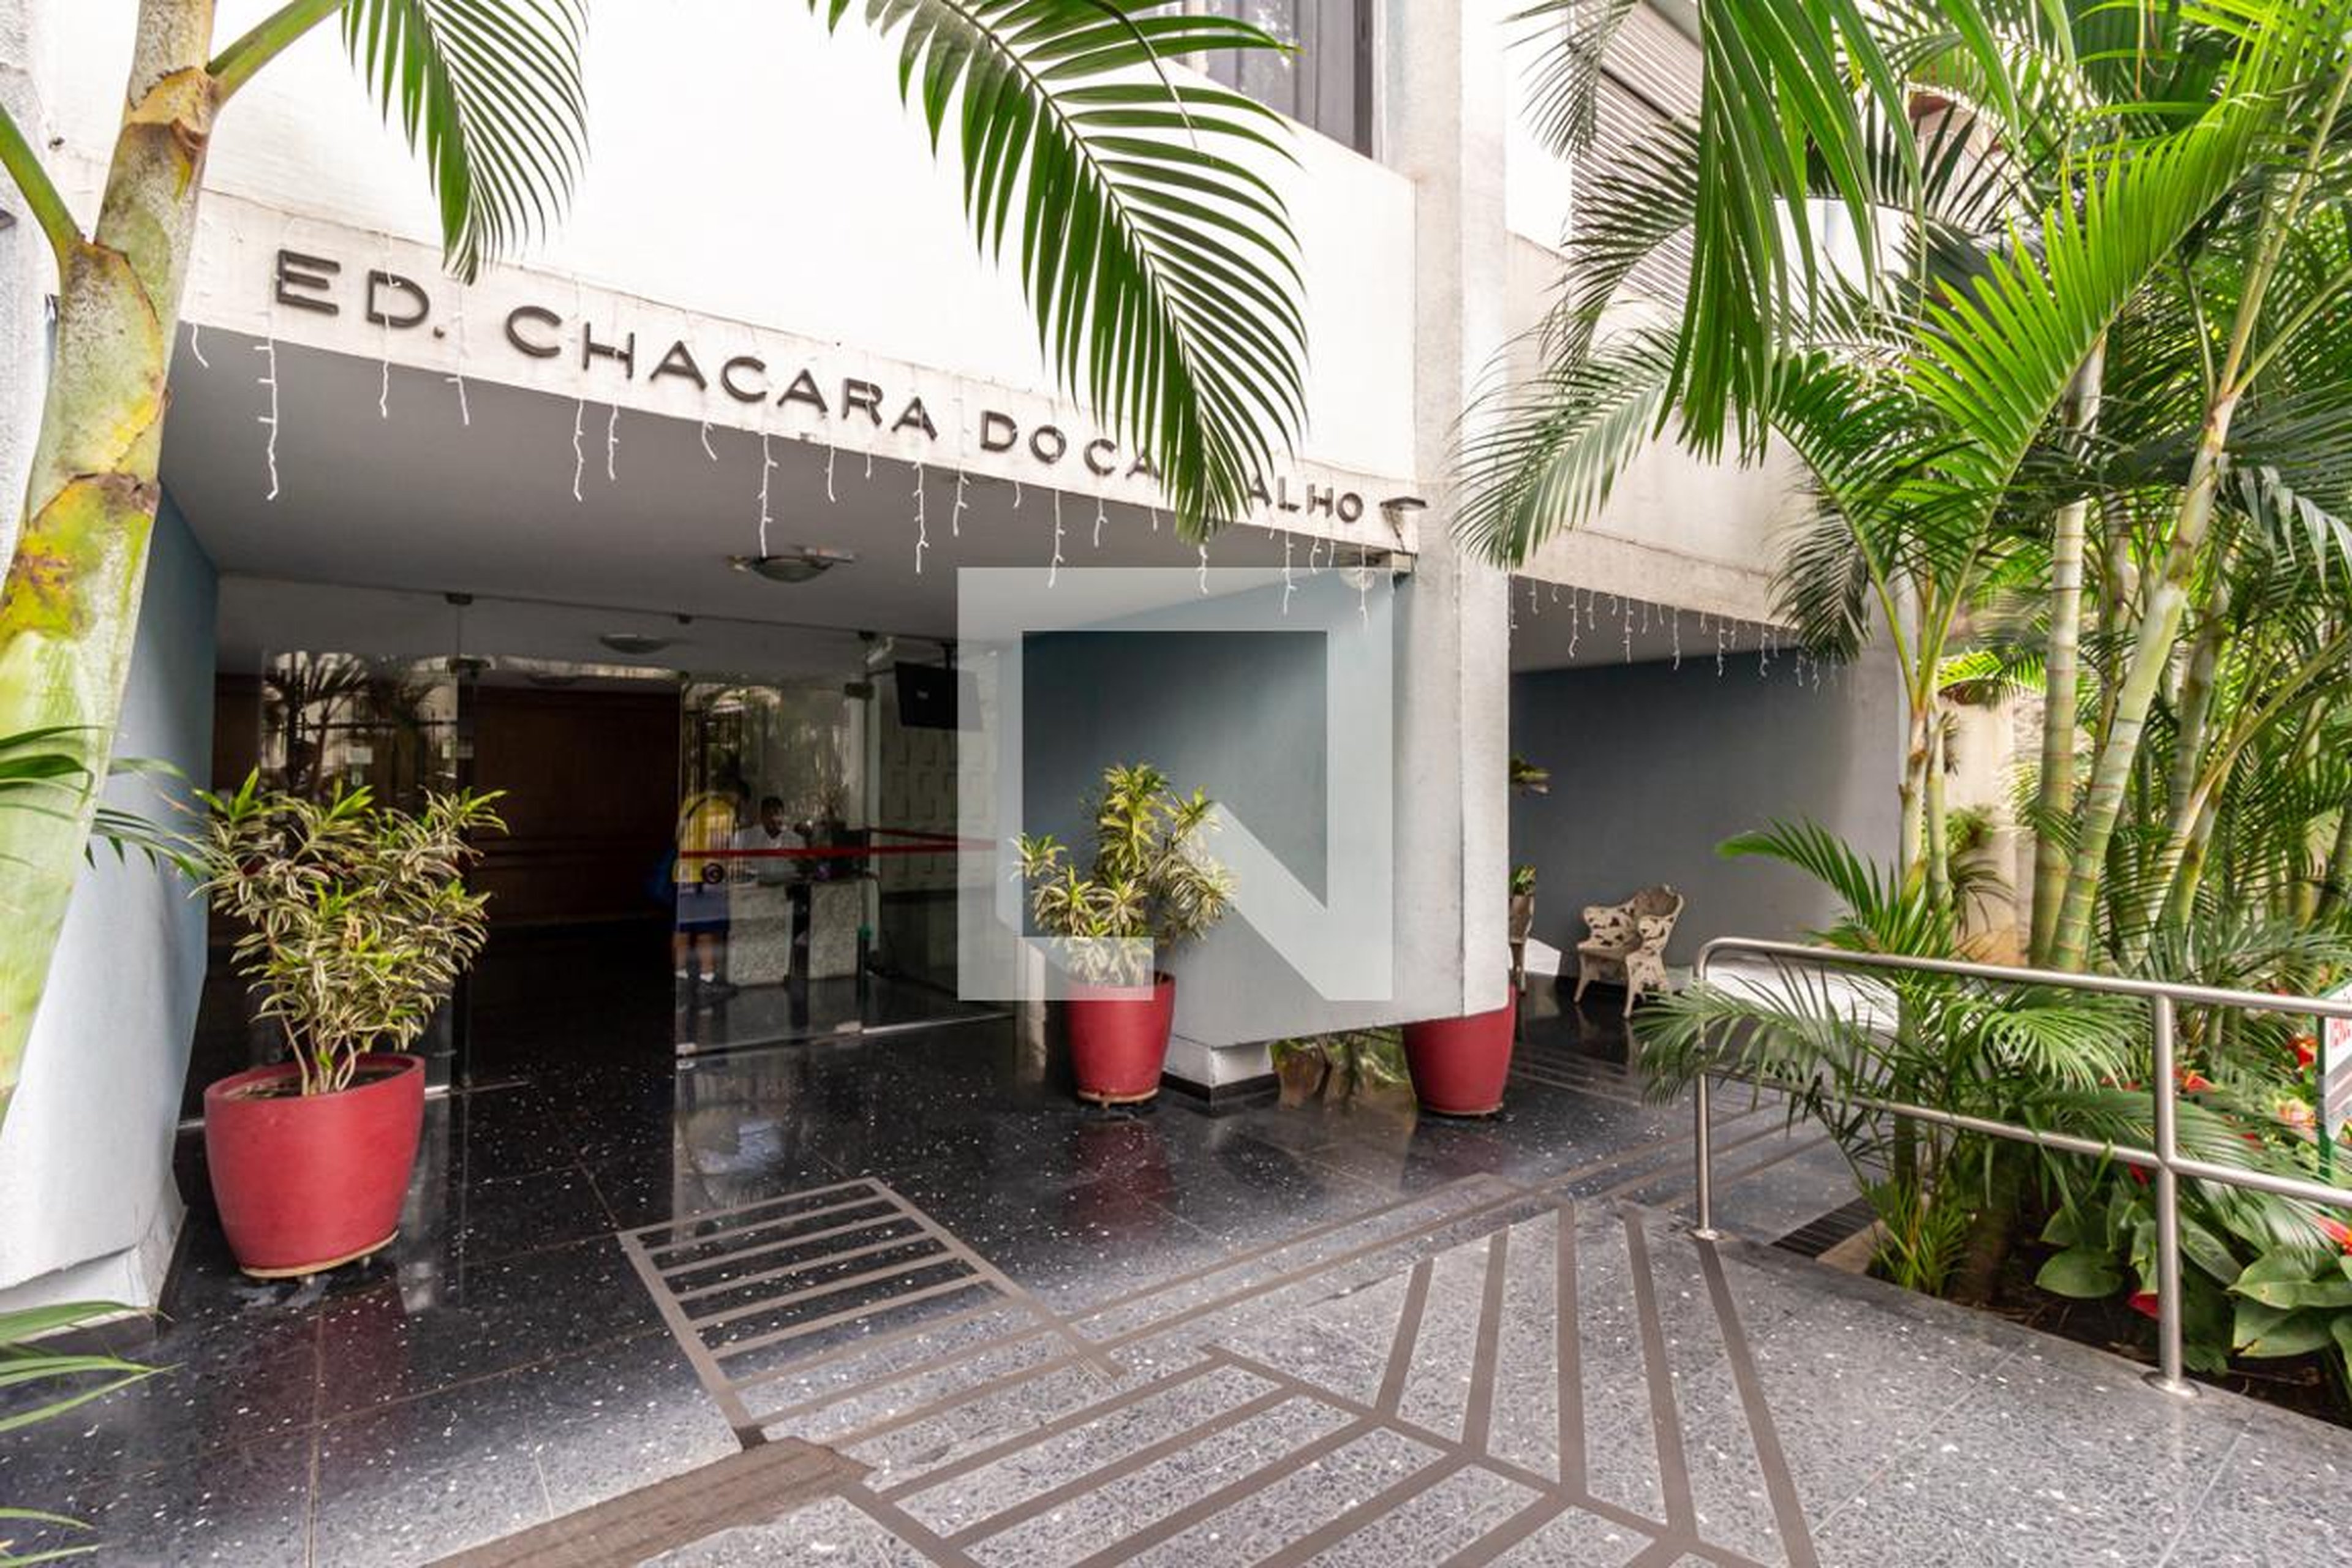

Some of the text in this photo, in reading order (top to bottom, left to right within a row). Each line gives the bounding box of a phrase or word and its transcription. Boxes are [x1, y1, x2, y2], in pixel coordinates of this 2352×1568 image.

[276, 249, 1363, 523] ED. CHACARA DO CAALHO
